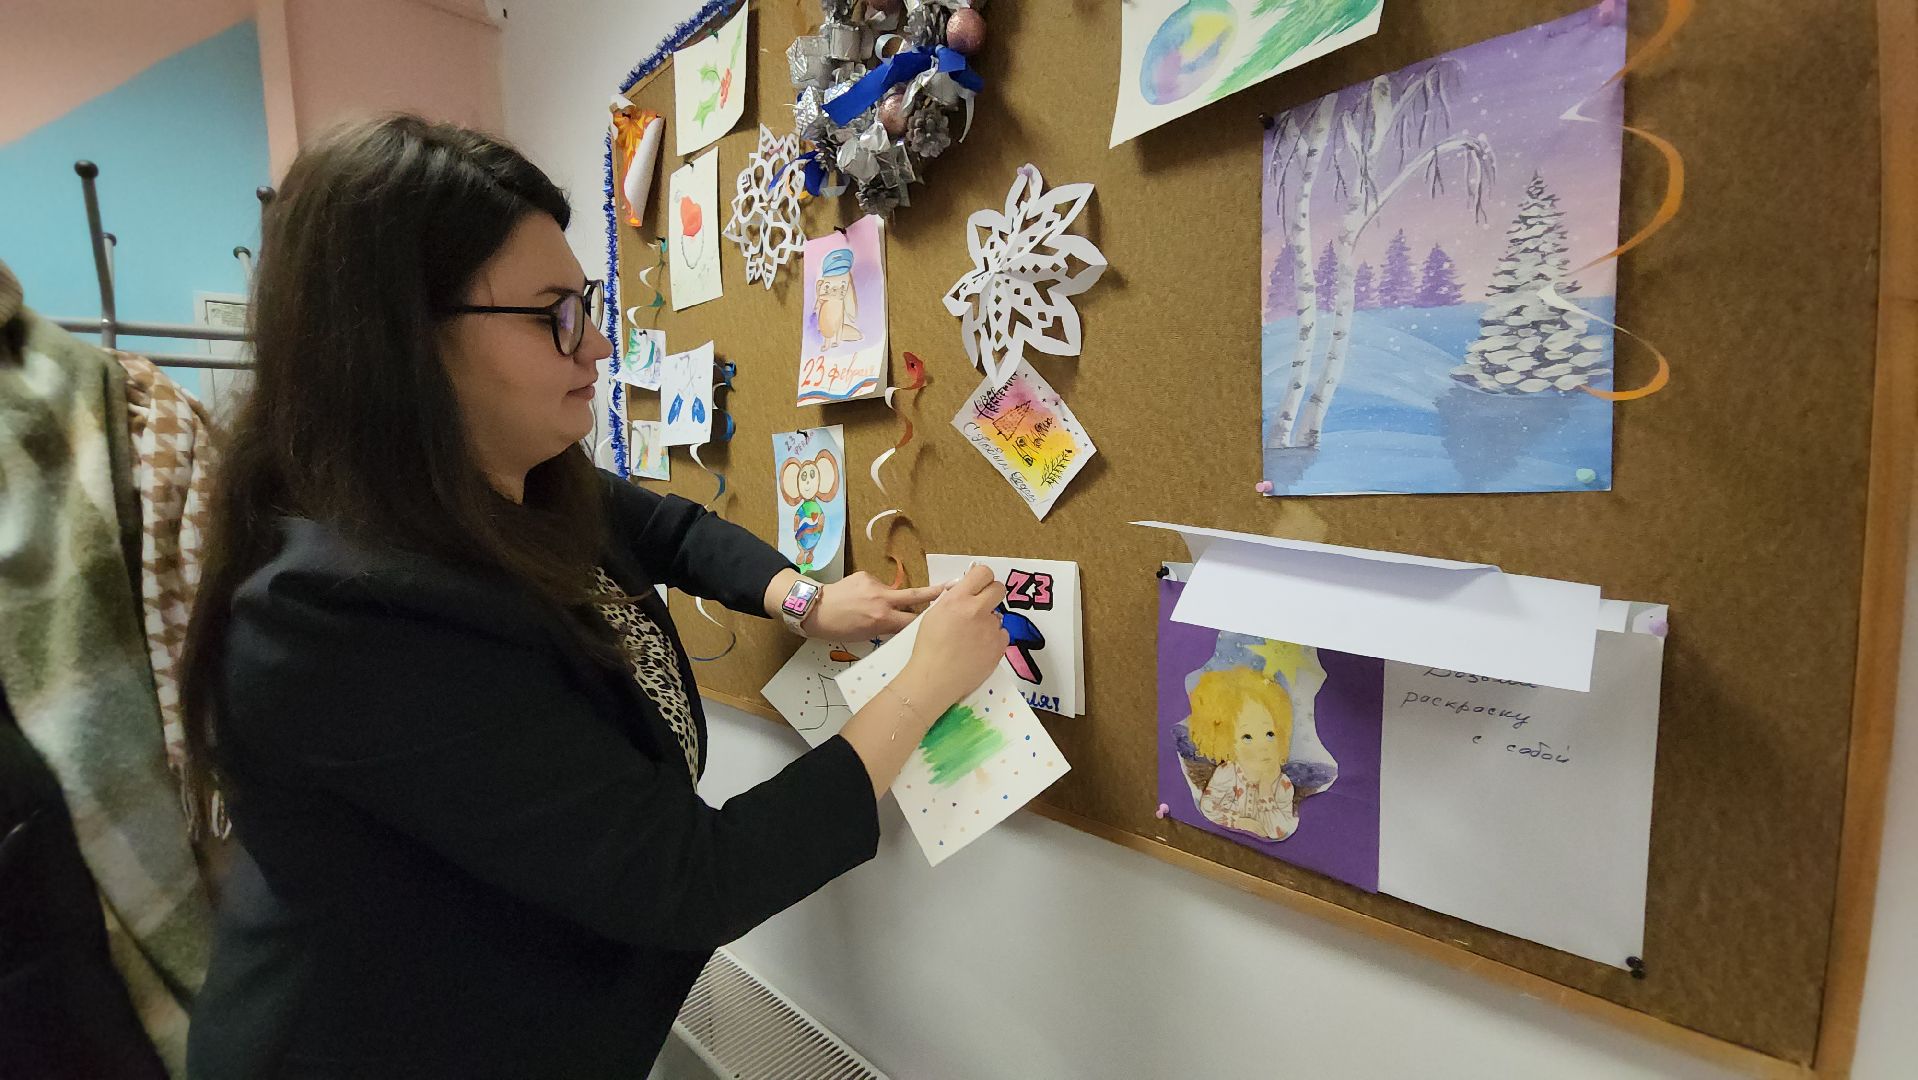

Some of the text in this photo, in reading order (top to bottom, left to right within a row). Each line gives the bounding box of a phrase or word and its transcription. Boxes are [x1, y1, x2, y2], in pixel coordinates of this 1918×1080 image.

[801, 355, 825, 387] 23
[784, 596, 808, 613] 20
[1005, 568, 1053, 611] 23
[1018, 691, 1060, 712] ля!
[1401, 691, 1531, 729] раскраску
